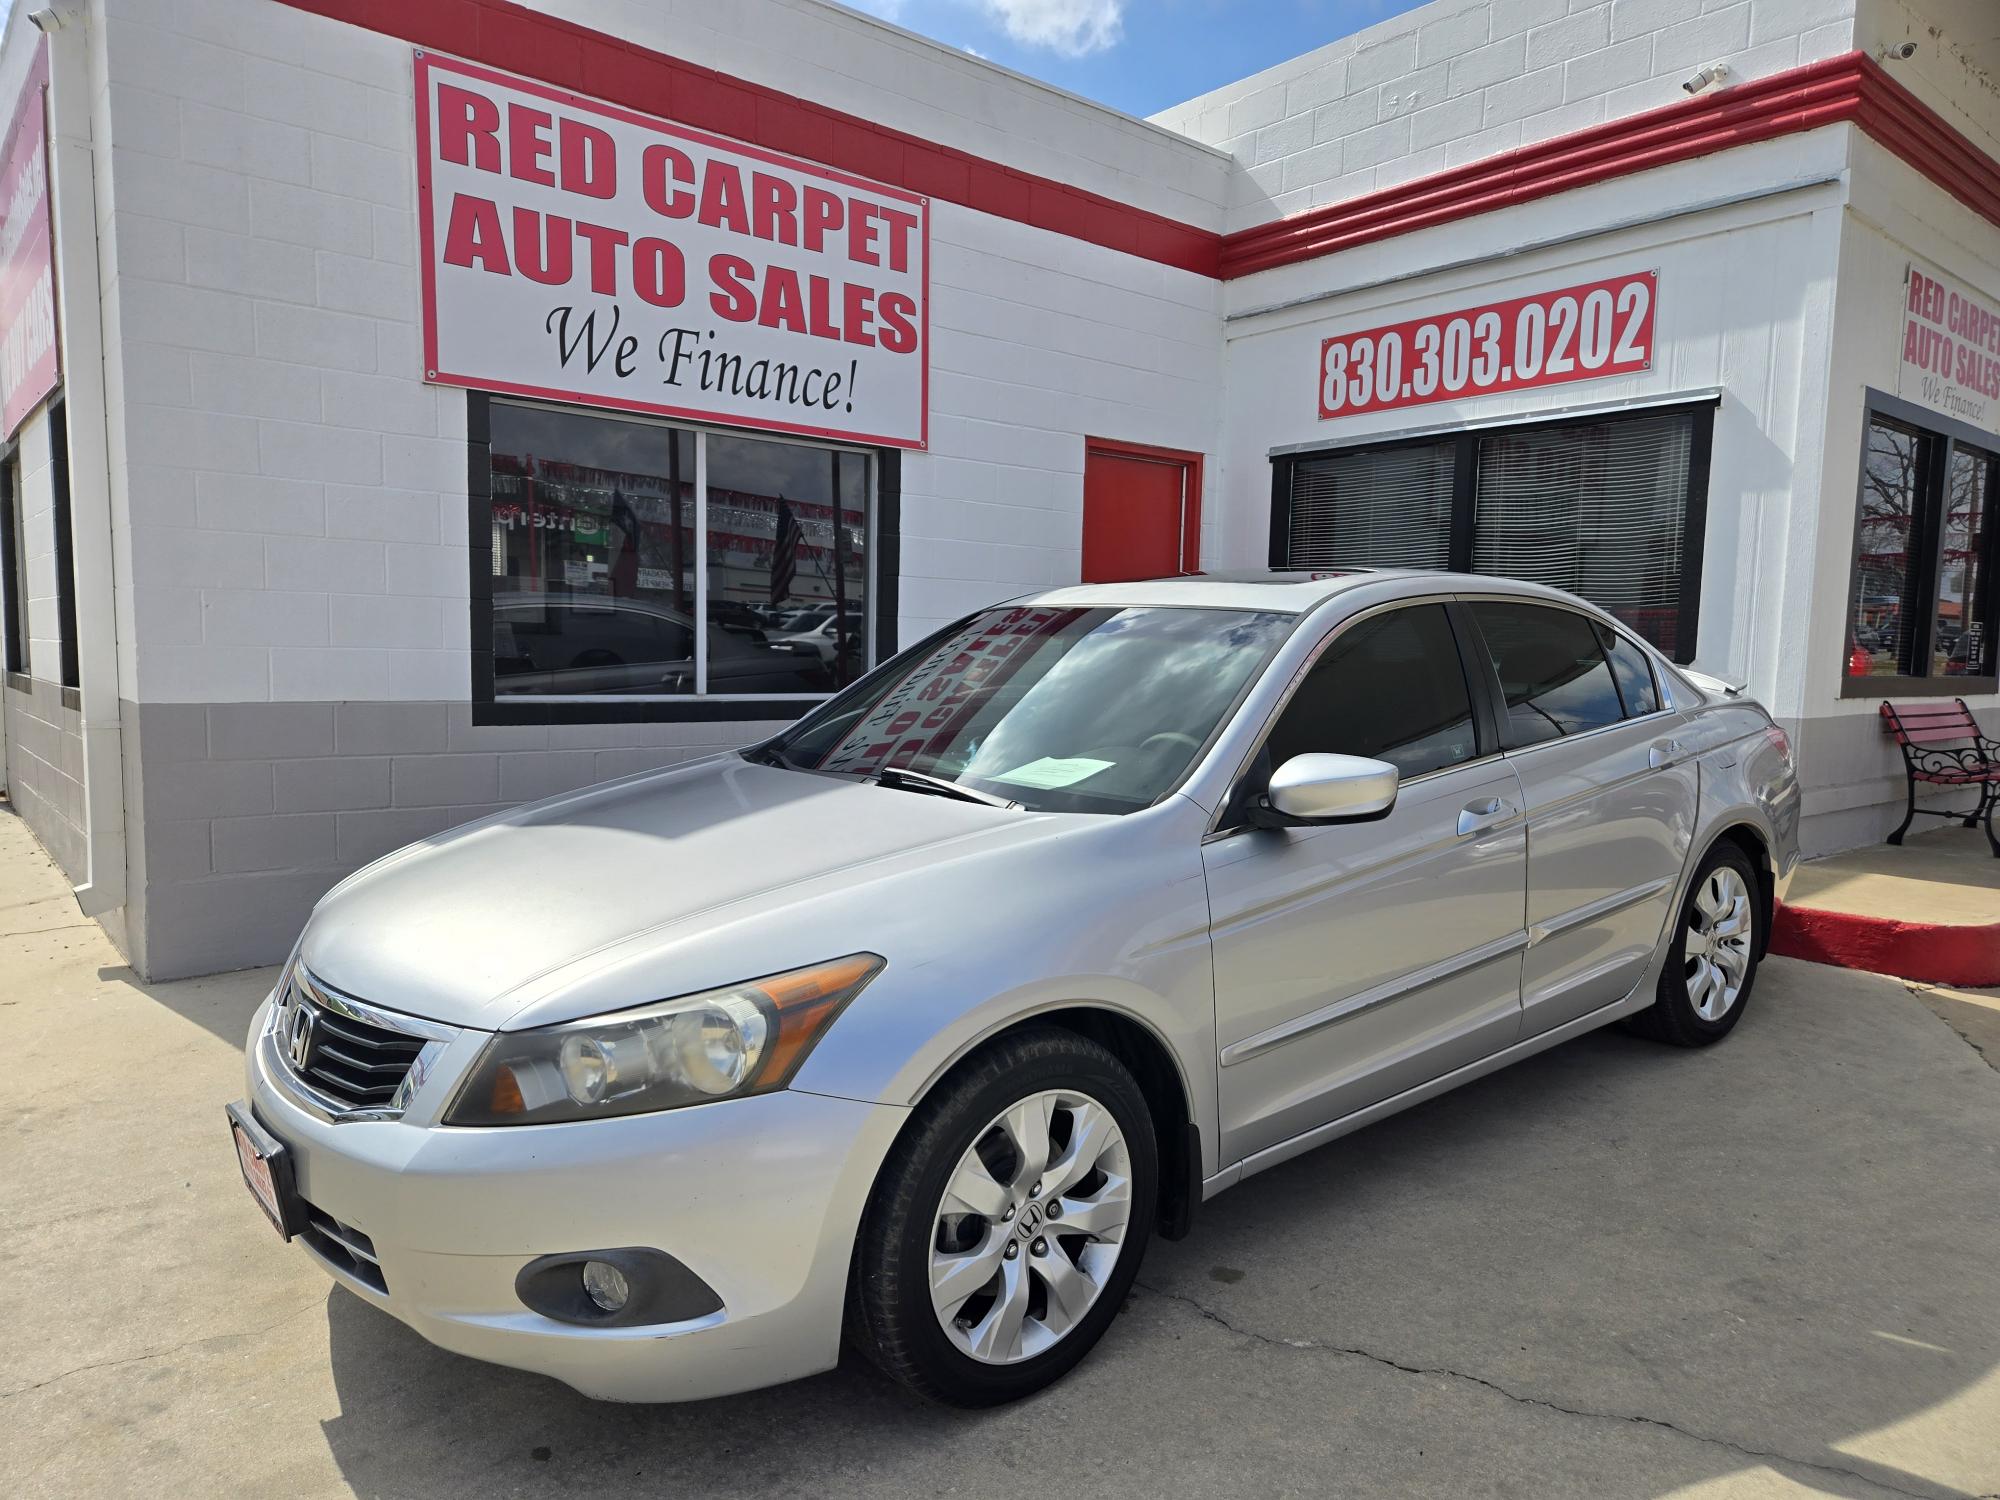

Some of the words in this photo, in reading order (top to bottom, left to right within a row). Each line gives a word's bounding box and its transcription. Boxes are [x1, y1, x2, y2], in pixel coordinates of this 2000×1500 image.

[437, 82, 617, 200] RED
[642, 143, 918, 274] CARPET
[442, 192, 686, 309] AUTO
[708, 253, 918, 354] SALES
[1908, 270, 1945, 325] RED
[545, 304, 639, 379] We
[658, 328, 857, 413] Finance!
[1322, 281, 1651, 411] 830.303.0202
[1903, 319, 1953, 379] AUTO
[1956, 343, 2000, 401] SALES
[1921, 376, 1940, 404] We
